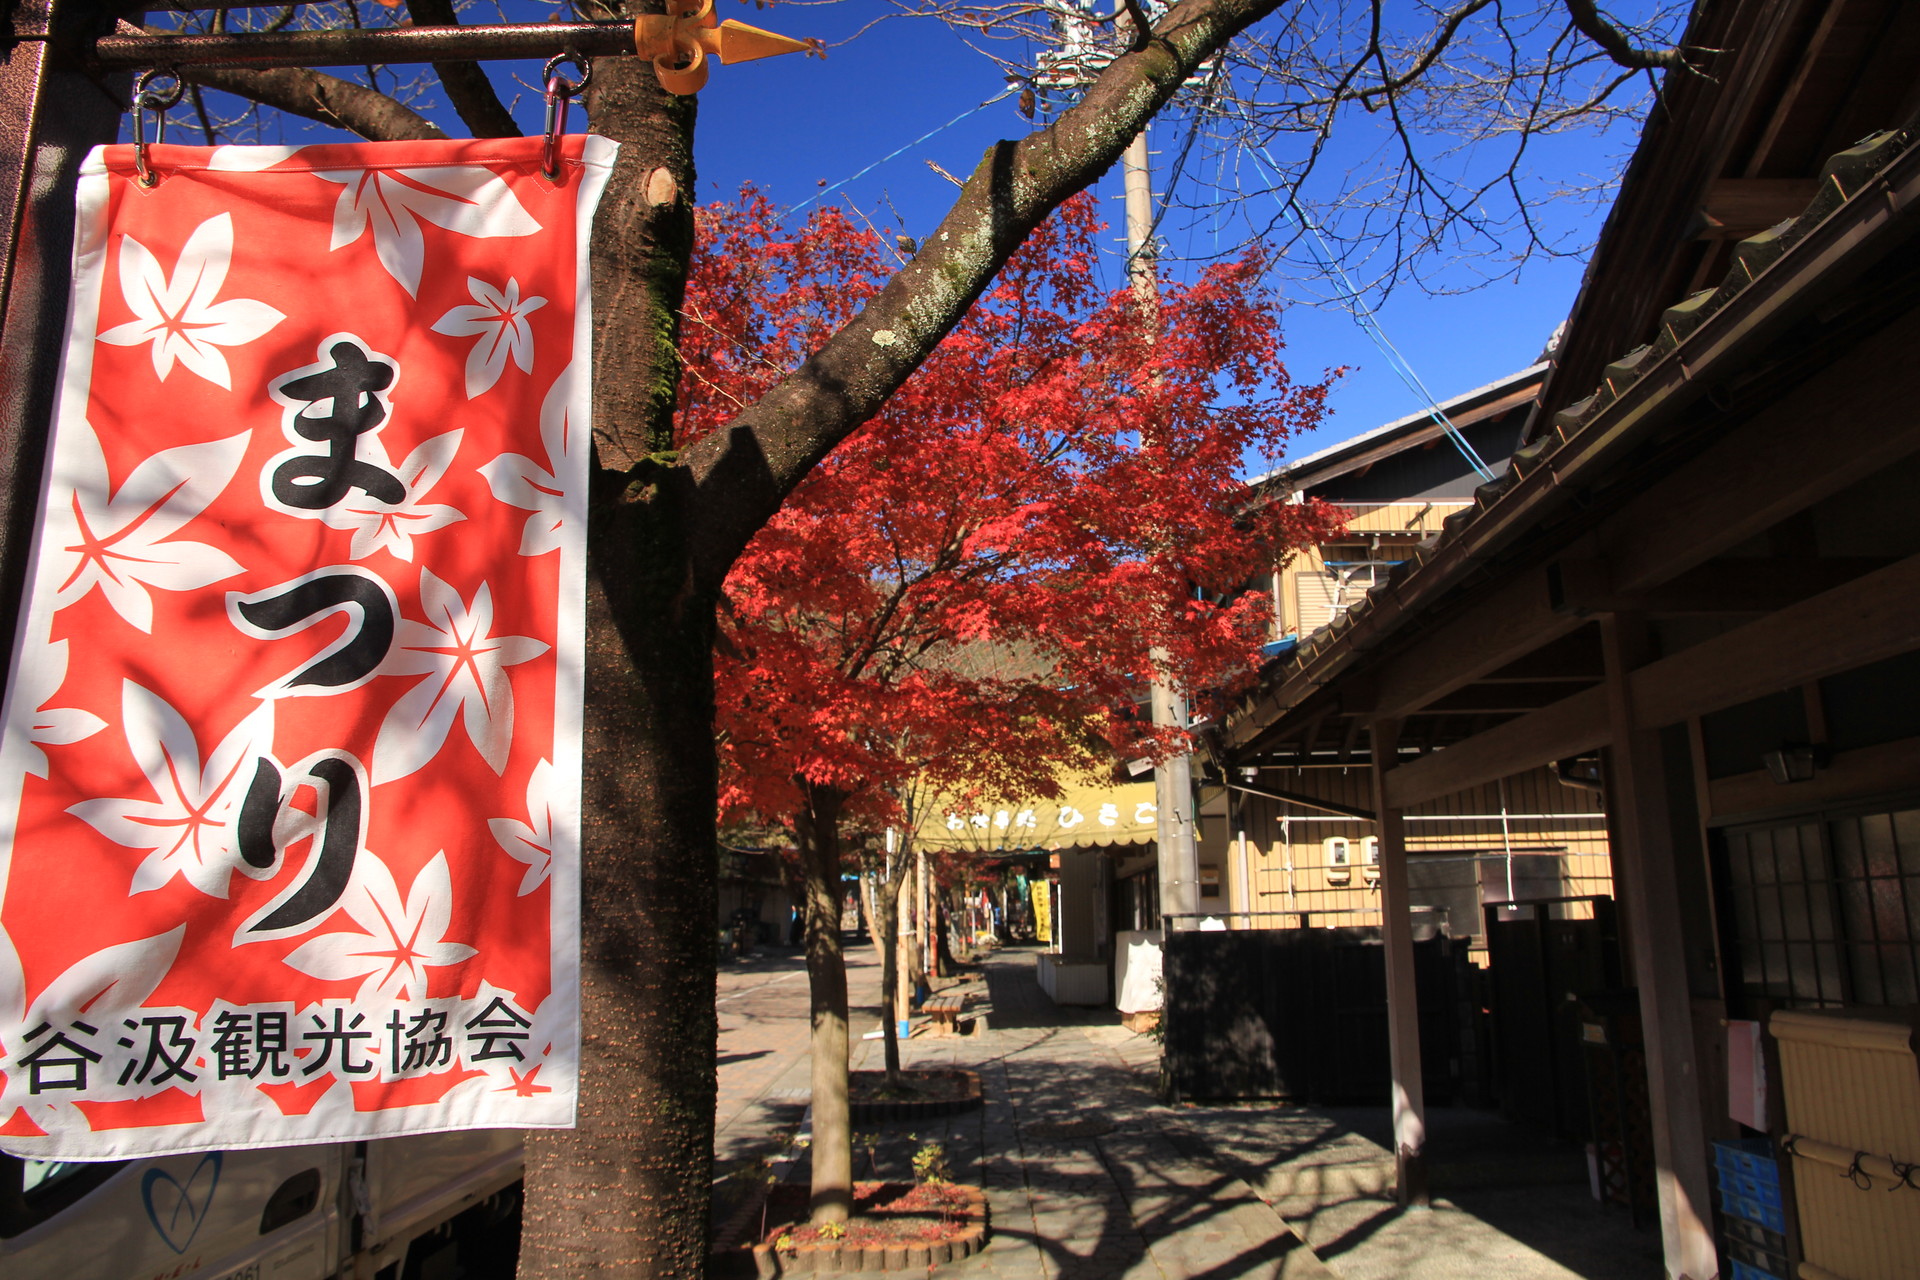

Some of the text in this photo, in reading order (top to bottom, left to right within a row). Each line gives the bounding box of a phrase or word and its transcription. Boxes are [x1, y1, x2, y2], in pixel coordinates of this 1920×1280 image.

[237, 341, 406, 932] まつり
[16, 996, 532, 1095] 谷汲観光協会
